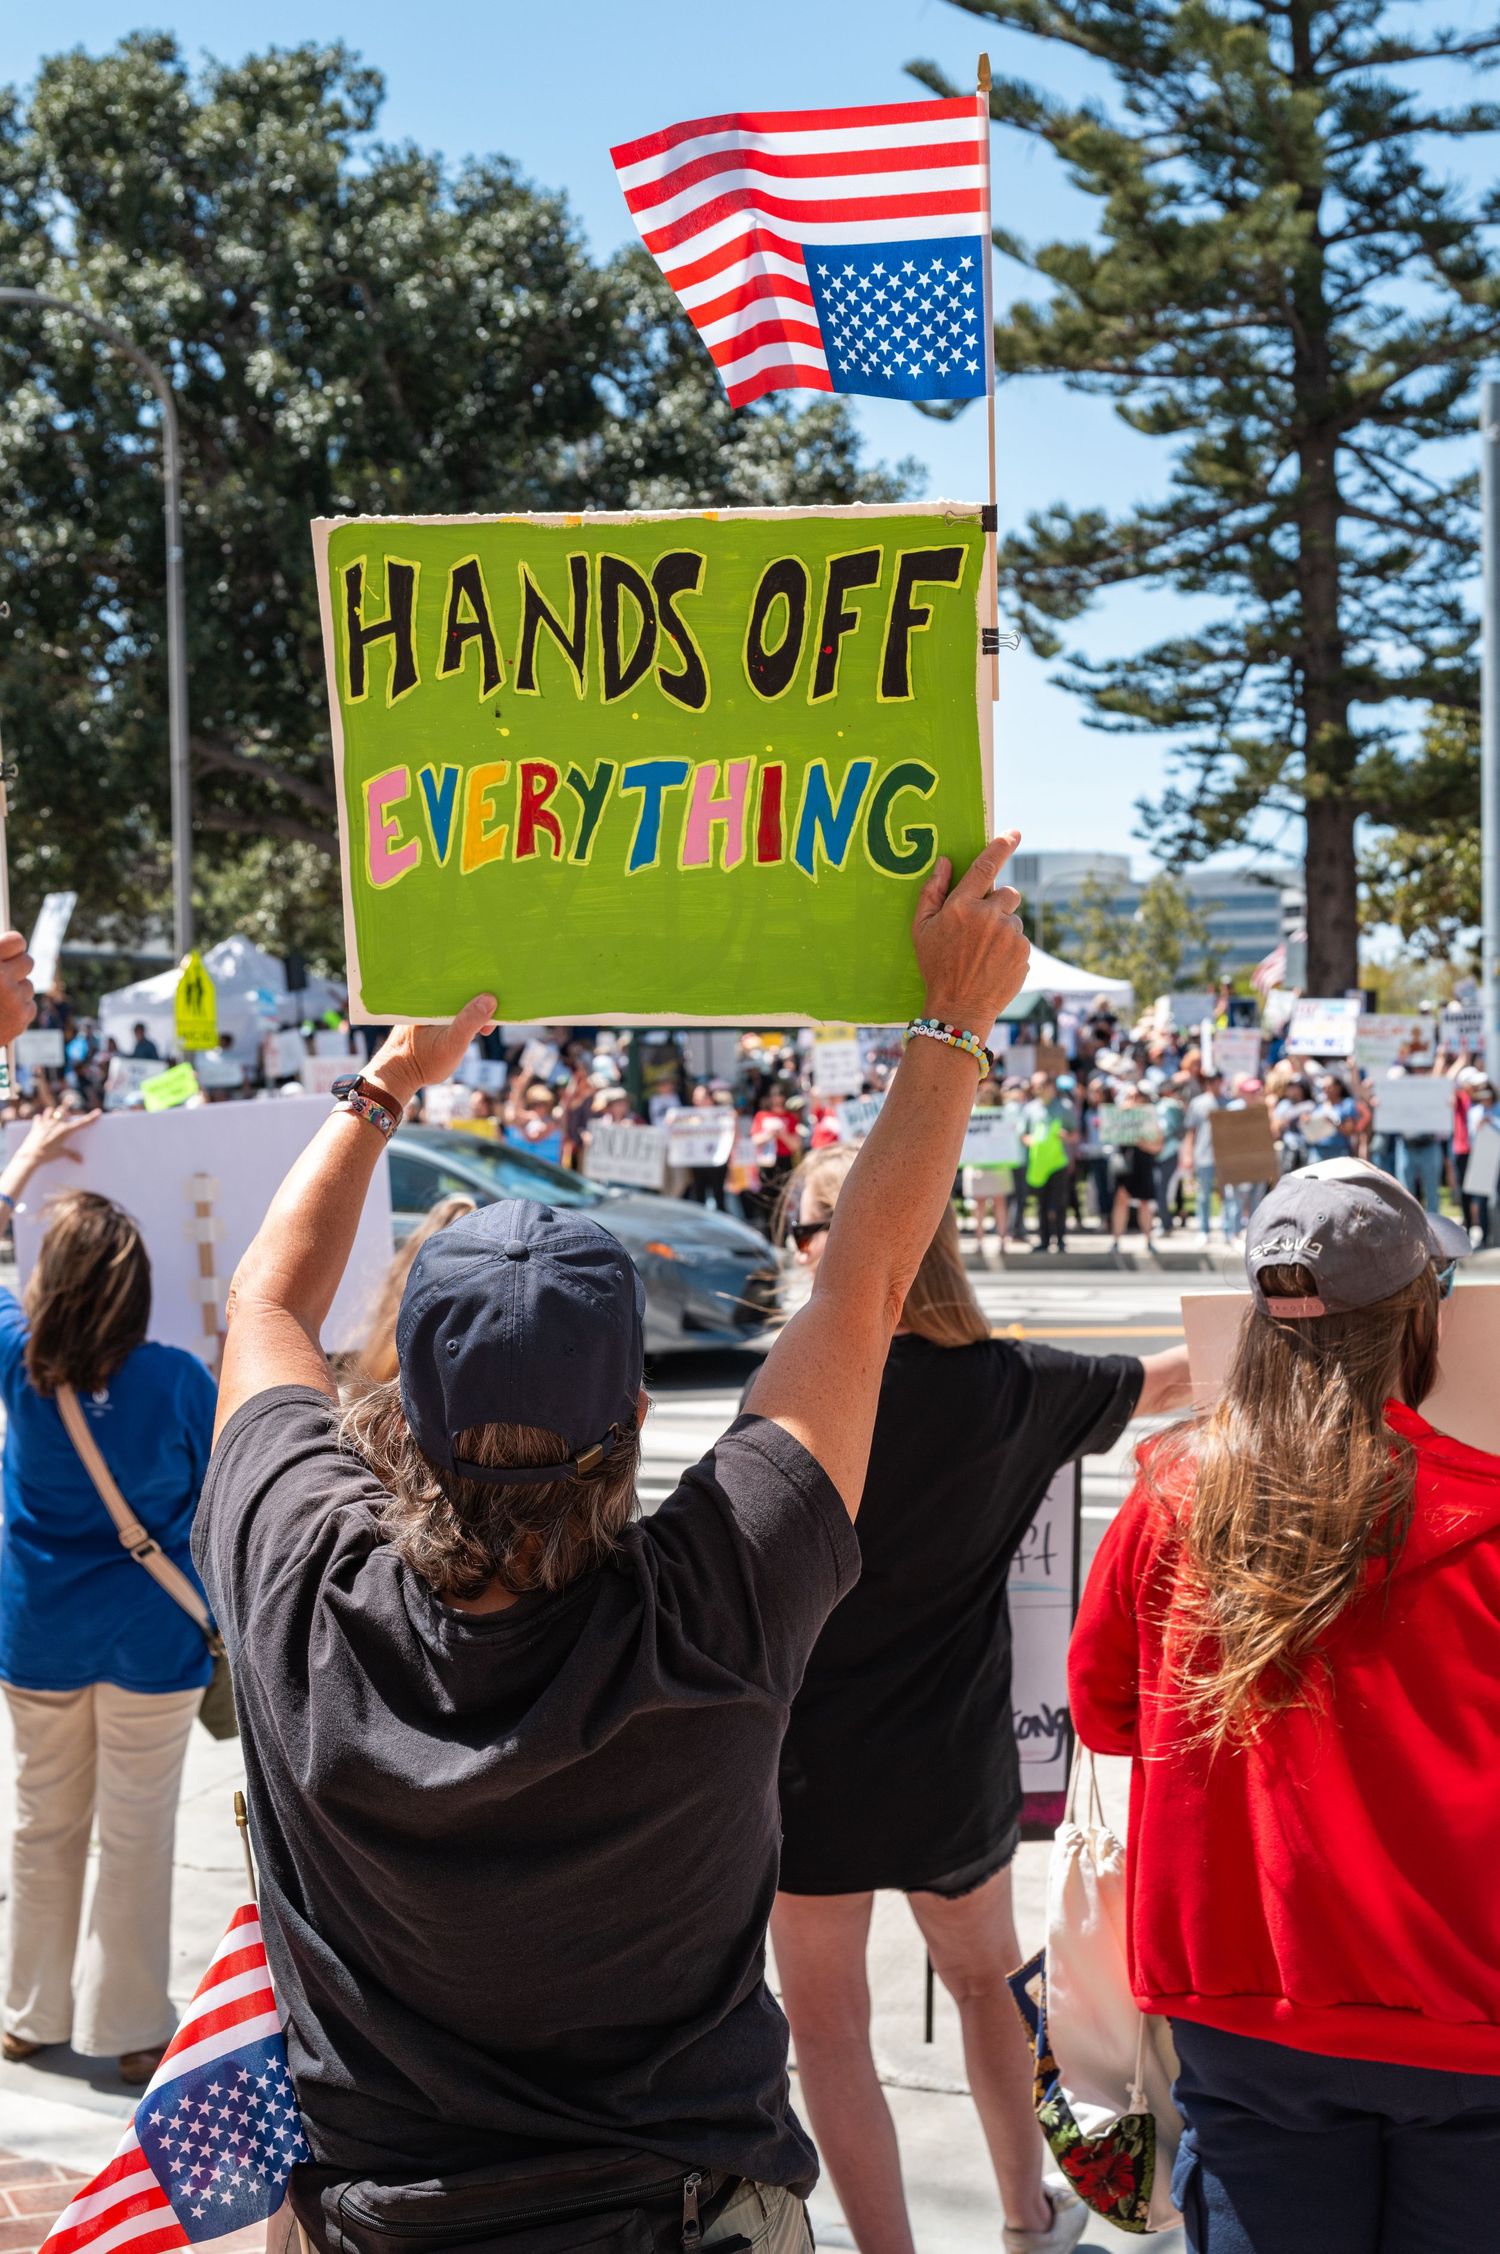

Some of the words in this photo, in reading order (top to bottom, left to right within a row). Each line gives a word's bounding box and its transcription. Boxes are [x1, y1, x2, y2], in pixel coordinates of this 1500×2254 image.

[341, 547, 710, 713] HANDS
[742, 544, 970, 705] OFF
[361, 755, 940, 890] EVERYTHING
